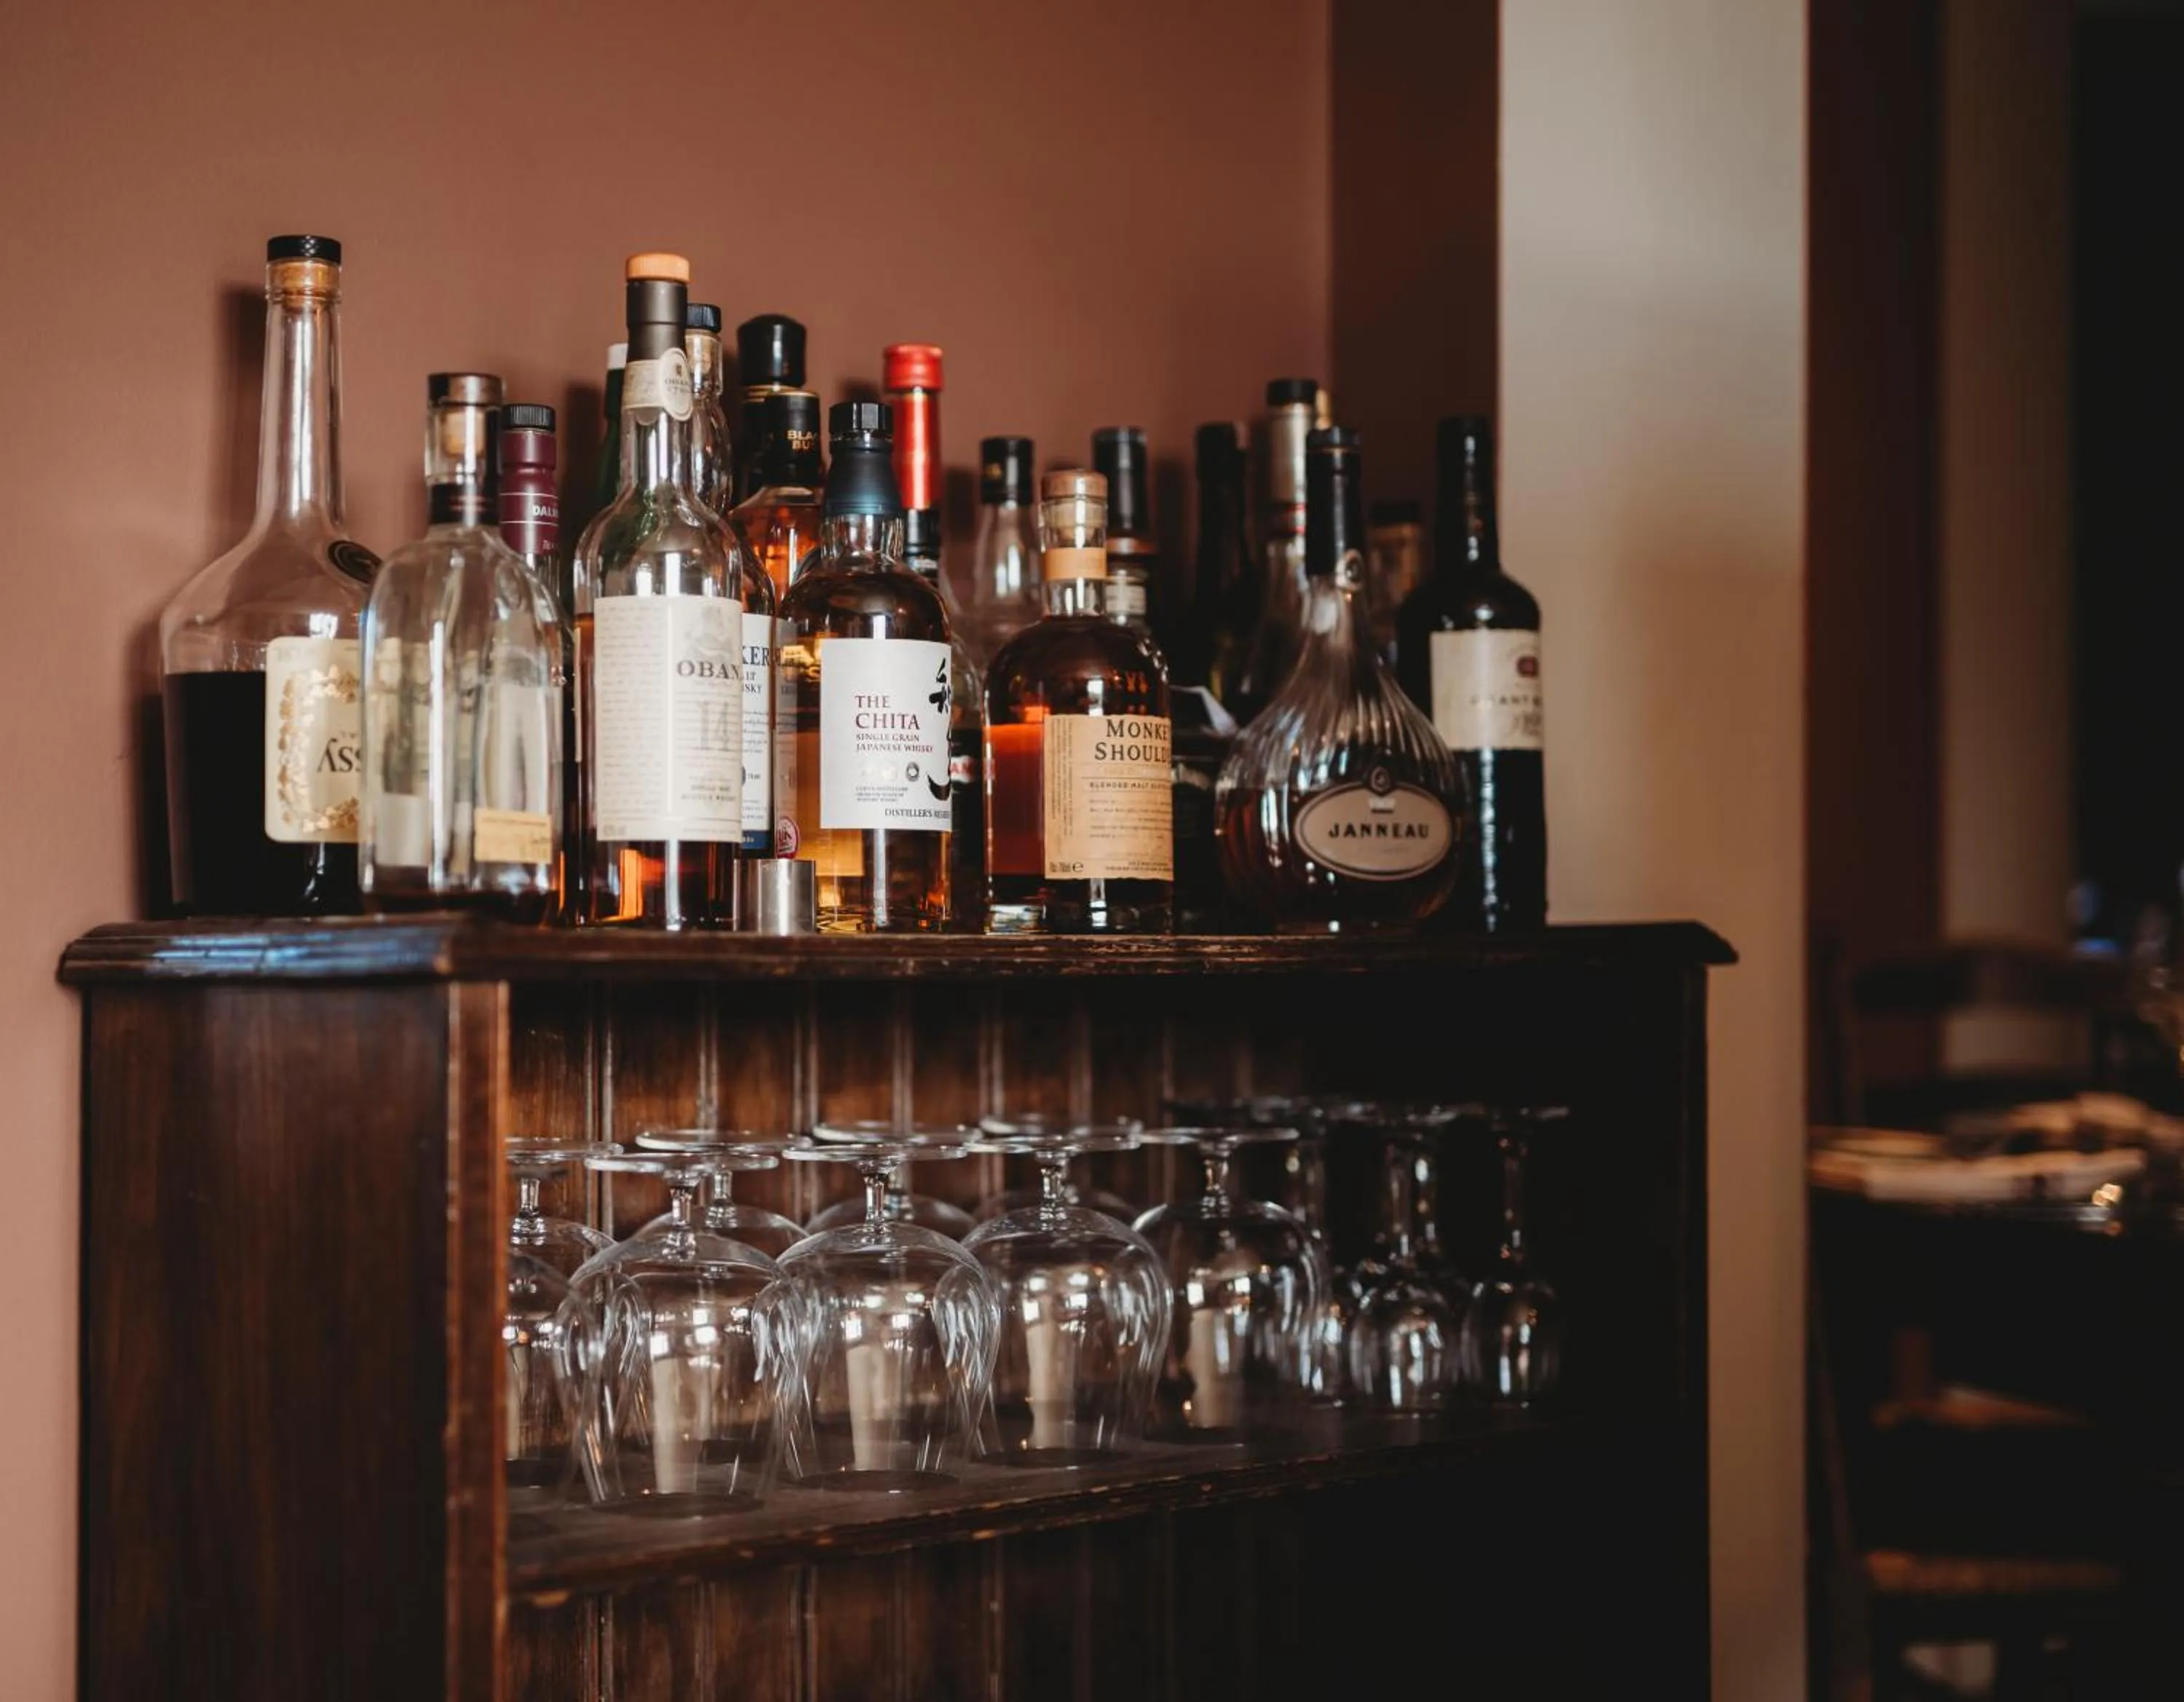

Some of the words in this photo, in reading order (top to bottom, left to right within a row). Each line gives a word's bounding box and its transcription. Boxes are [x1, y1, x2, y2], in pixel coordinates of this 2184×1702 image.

[787, 430, 816, 440] BLA
[855, 695, 891, 708] THE
[855, 713, 920, 730] CHITA
[856, 733, 890, 741] SINGLE
[892, 734, 919, 742] GRAIN
[856, 743, 902, 752] JAPANESE
[904, 744, 933, 753] WHISKY
[1329, 823, 1430, 839] JANNEAU
